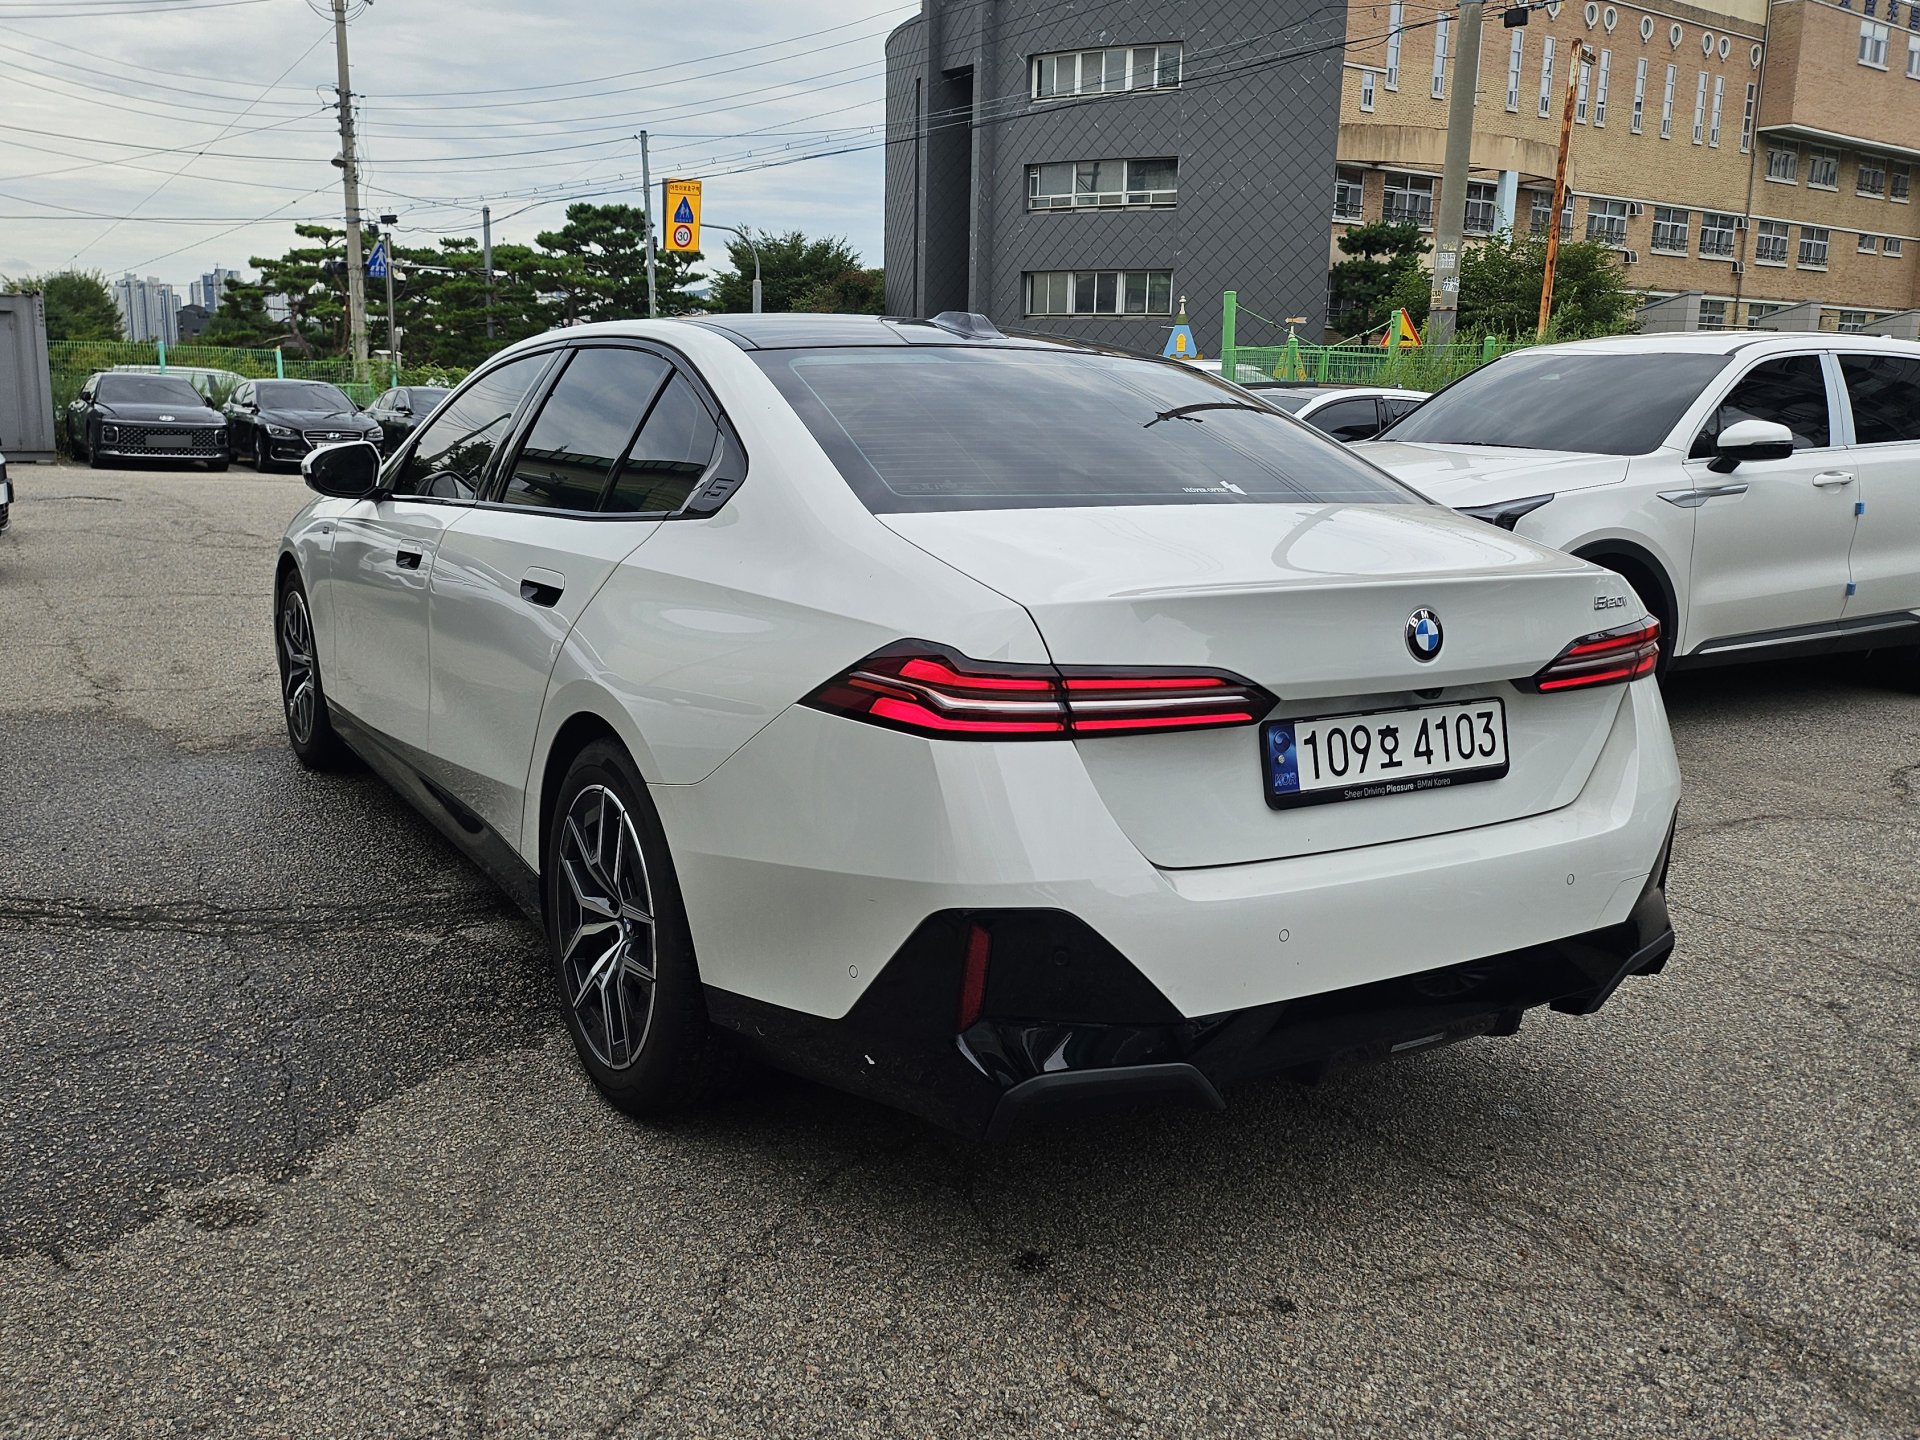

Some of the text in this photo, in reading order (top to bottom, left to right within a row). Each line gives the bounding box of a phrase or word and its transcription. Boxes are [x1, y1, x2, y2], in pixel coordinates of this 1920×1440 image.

[677, 231, 689, 242] 30
[1594, 595, 1628, 611] 520i
[1410, 610, 1440, 627] BMW
[1303, 711, 1497, 780] 109호 4103
[1274, 771, 1297, 787] KOR
[1344, 777, 1451, 799] Sheer Driving Pleasure BMW Korea
